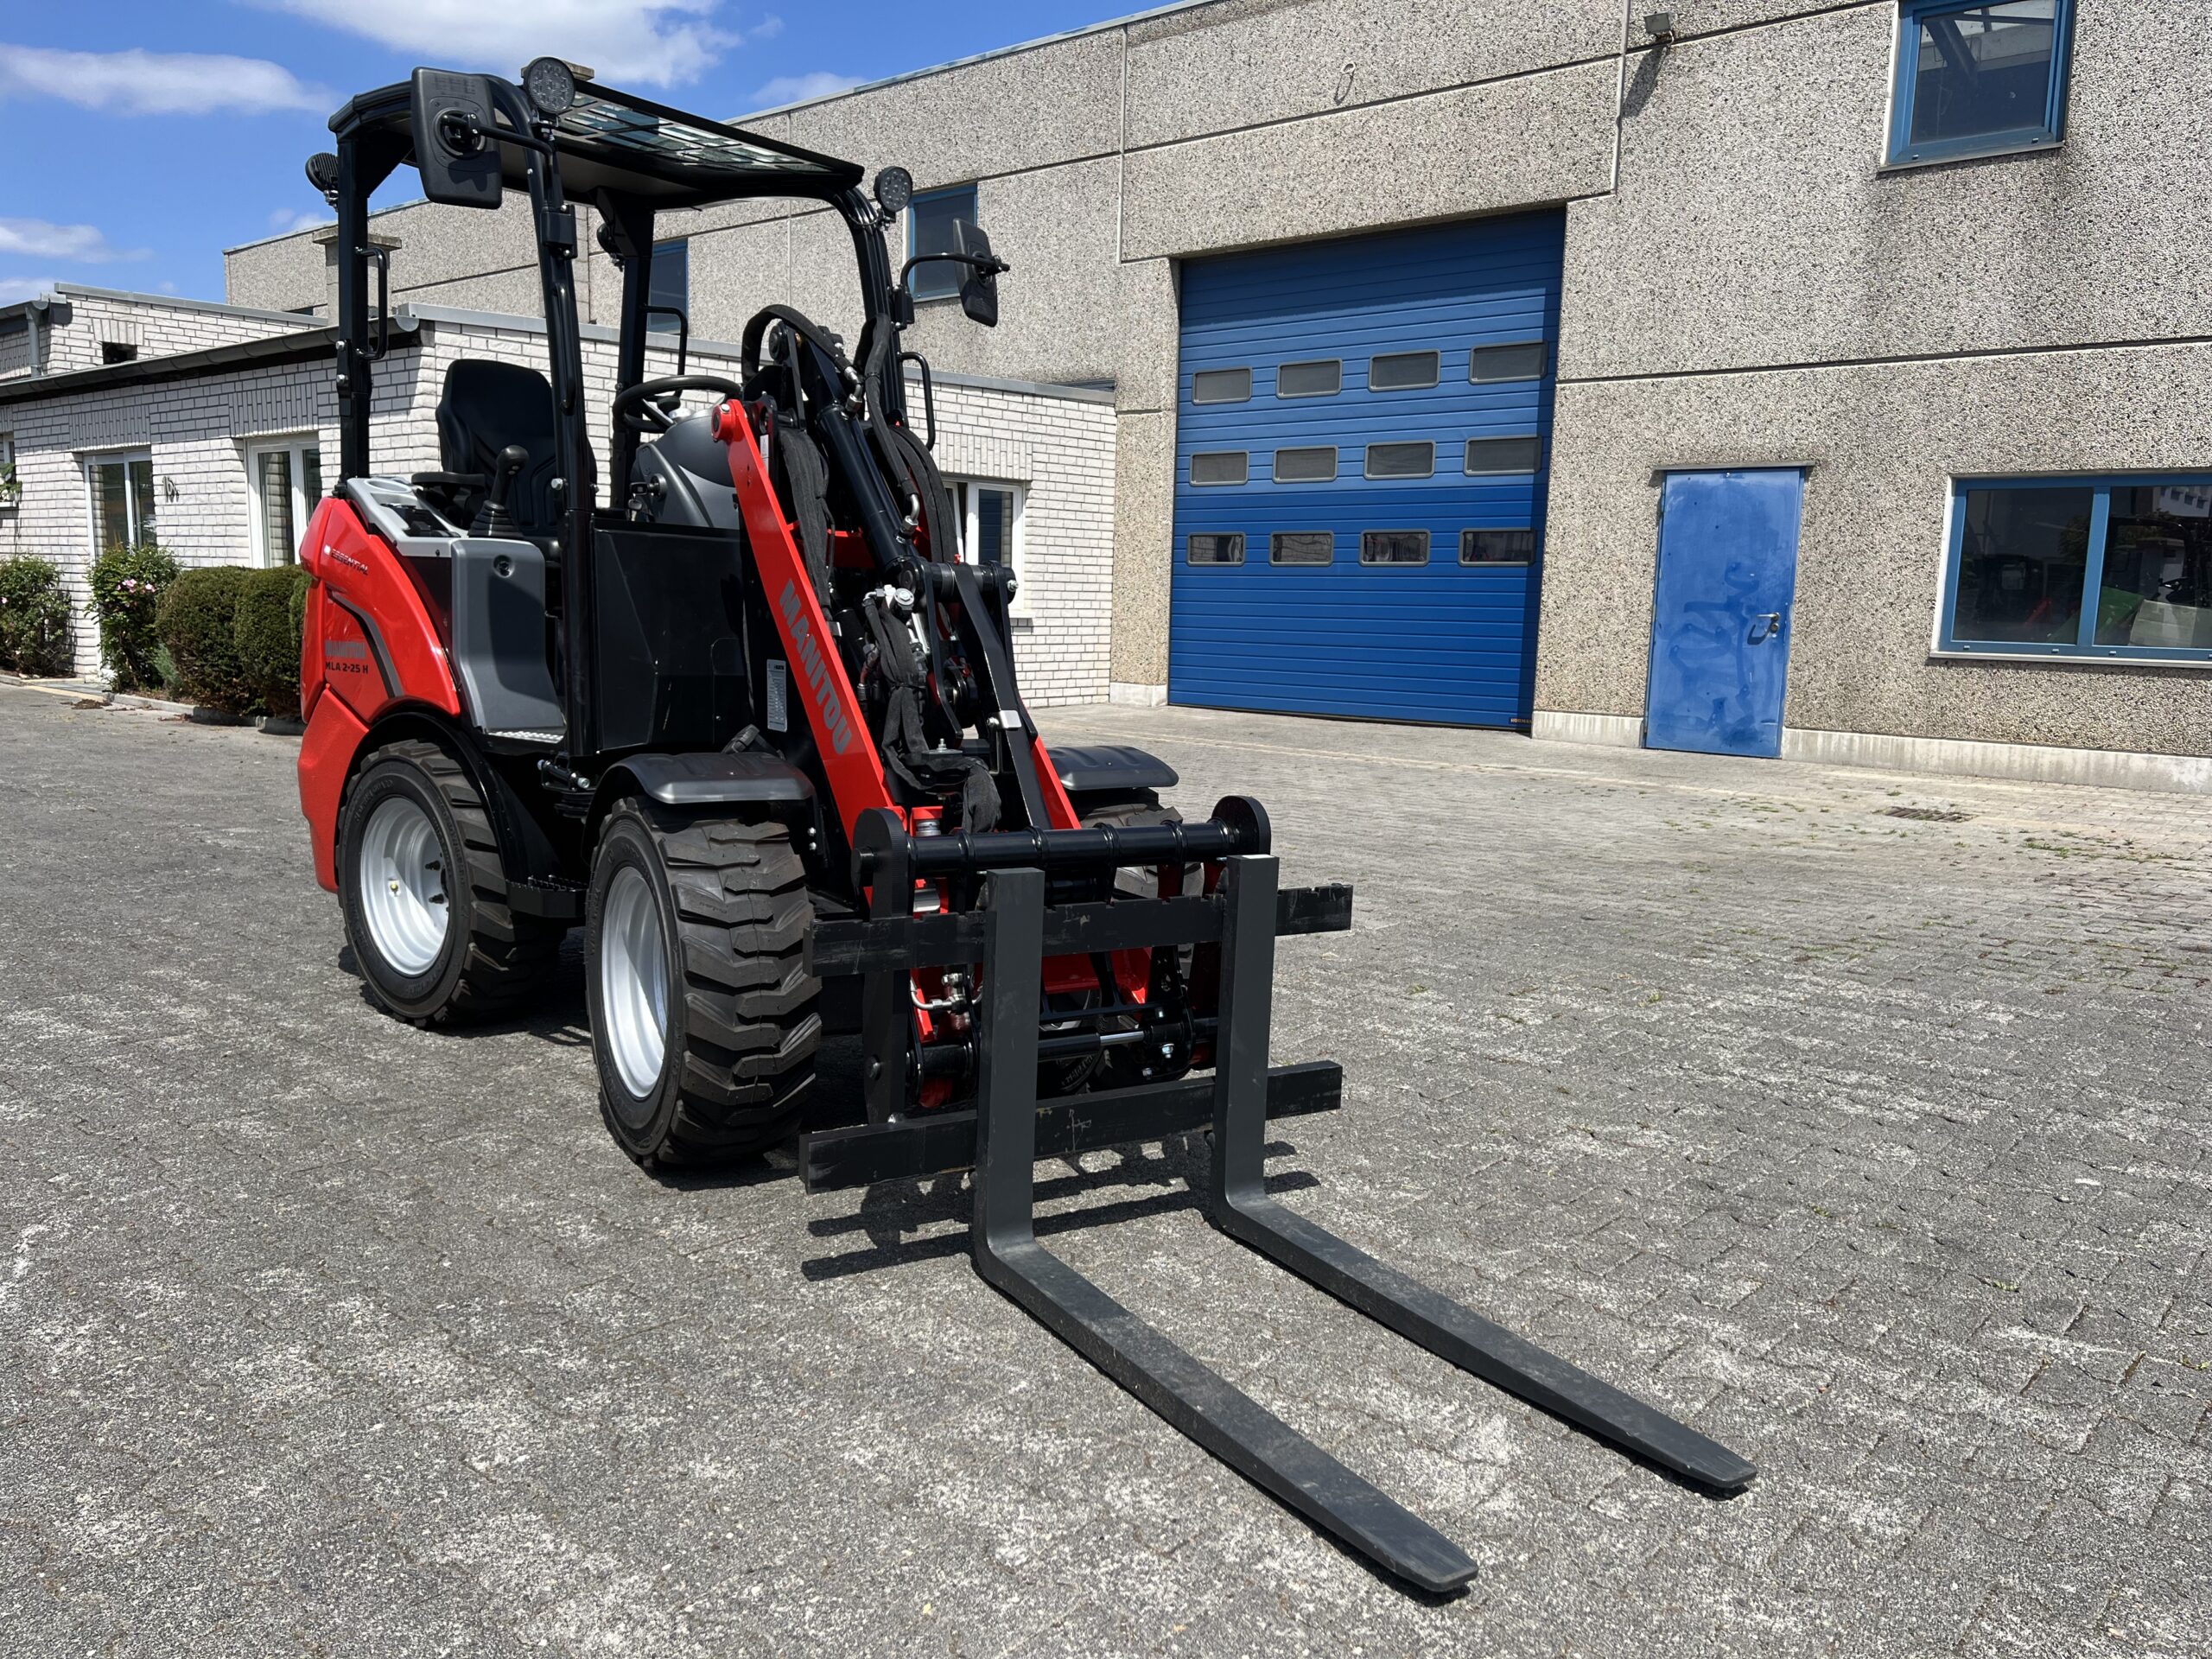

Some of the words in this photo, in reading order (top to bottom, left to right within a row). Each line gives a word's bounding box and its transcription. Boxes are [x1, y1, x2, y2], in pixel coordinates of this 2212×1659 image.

[325, 661, 341, 671] MLA
[363, 664, 369, 674] H
[779, 578, 852, 755] MANITOU
